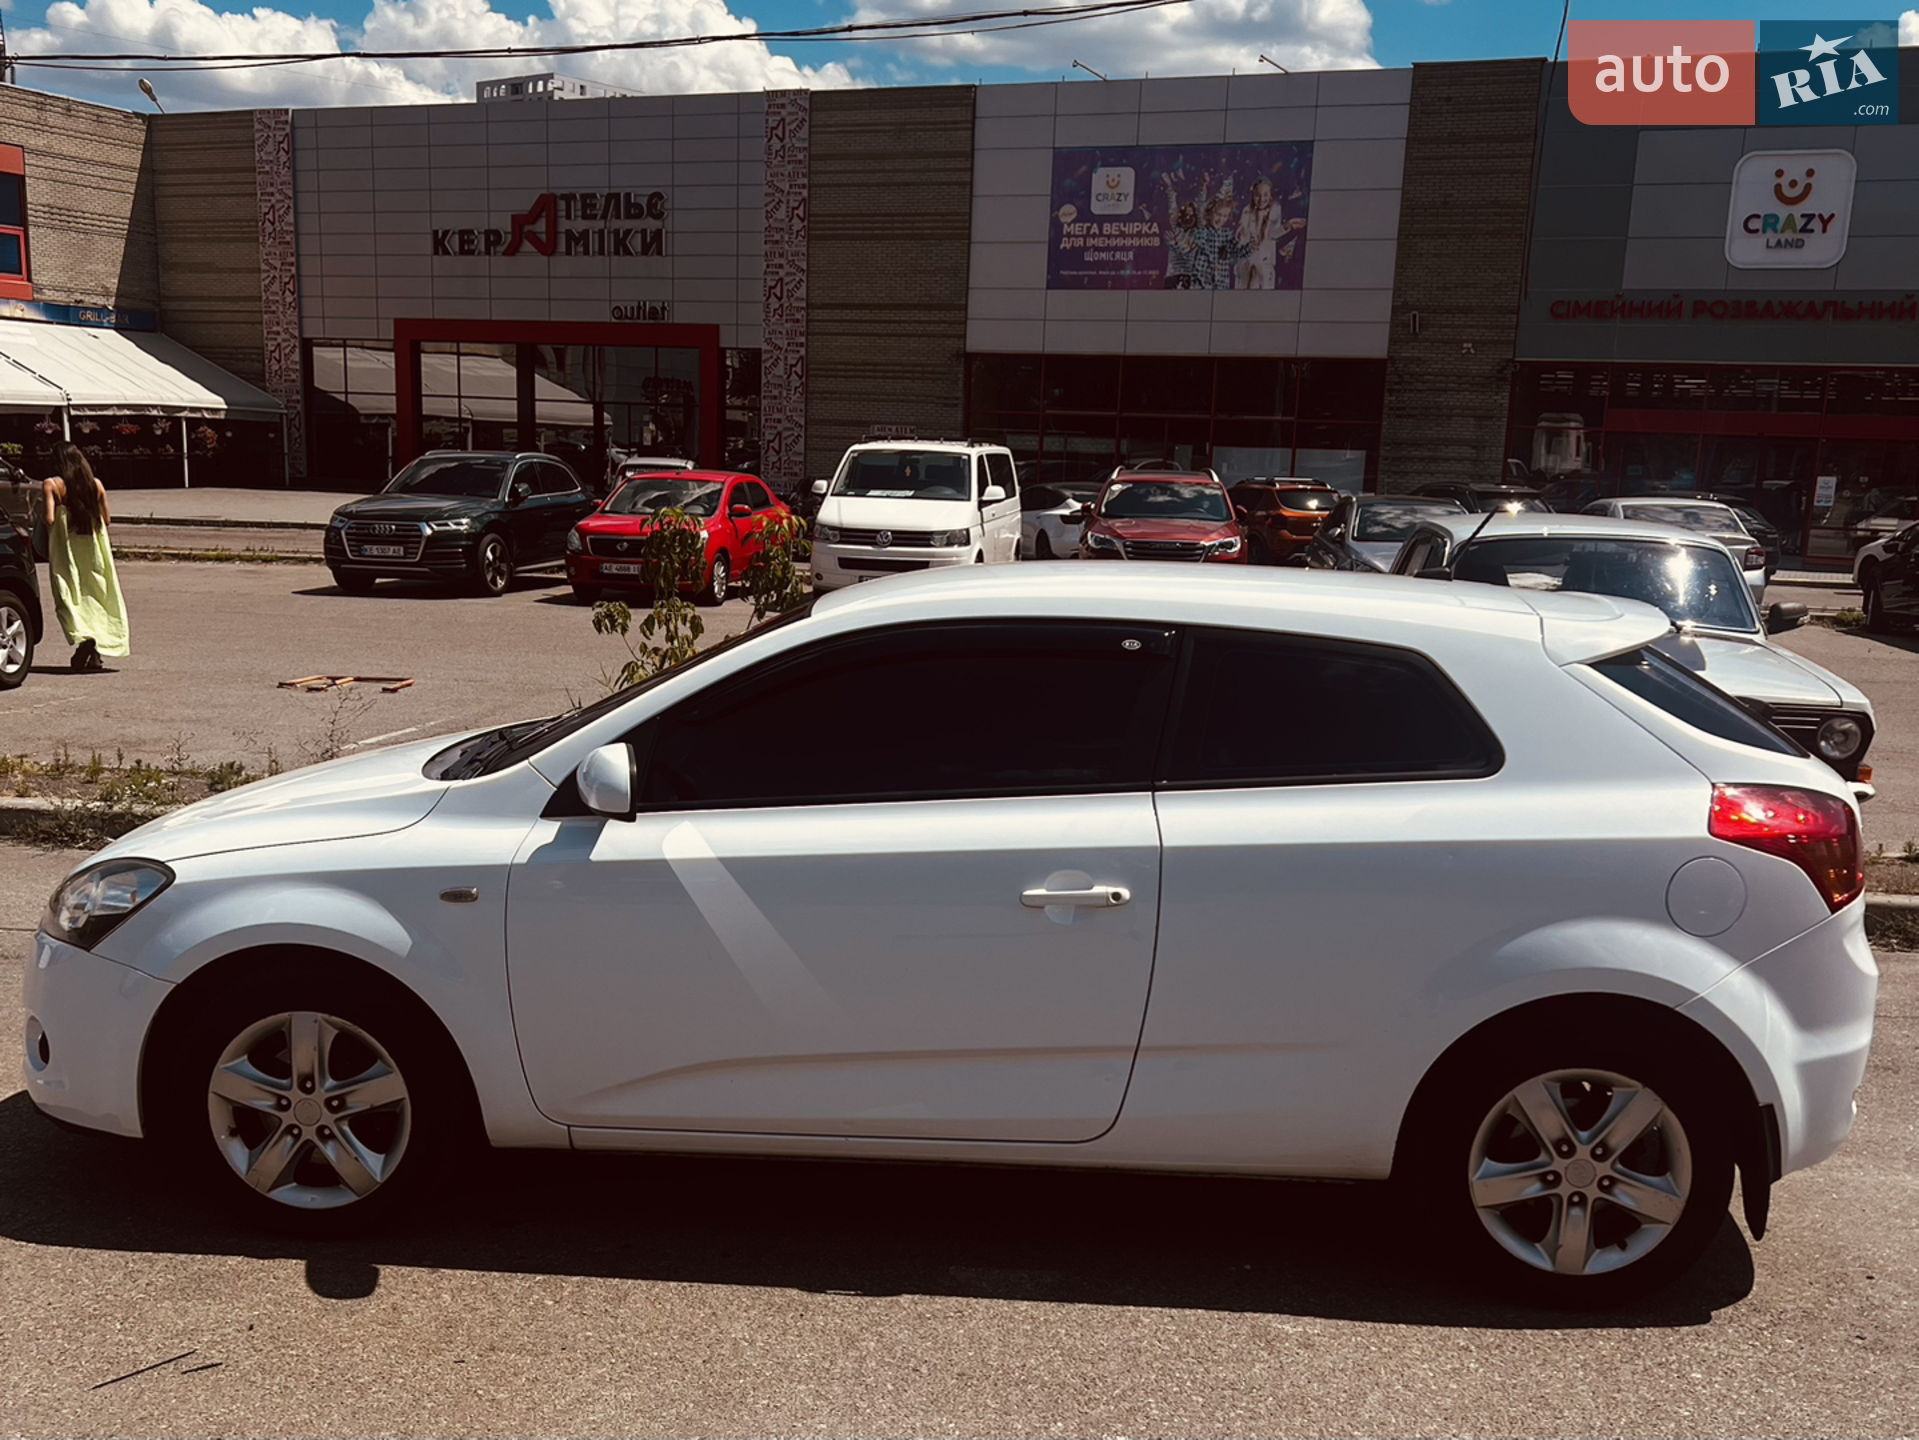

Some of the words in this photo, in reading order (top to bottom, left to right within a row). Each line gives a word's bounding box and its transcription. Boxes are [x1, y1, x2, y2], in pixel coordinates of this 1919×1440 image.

[1095, 192, 1129, 202] CRAZY
[1063, 222, 1100, 235] МЕГА
[1102, 222, 1160, 235] ВЕЧІРКА
[1742, 212, 1835, 234] CRAZY
[1059, 237, 1084, 250] ДЛЯ
[1086, 236, 1161, 247] ІМЕНИННИКІВ
[1765, 238, 1806, 249] LAND
[611, 301, 669, 321] outlet
[1549, 294, 1684, 321] СІМЕЙНИЙ
[1692, 294, 1918, 321] РОЗВАЖАЛЬНИЙ
